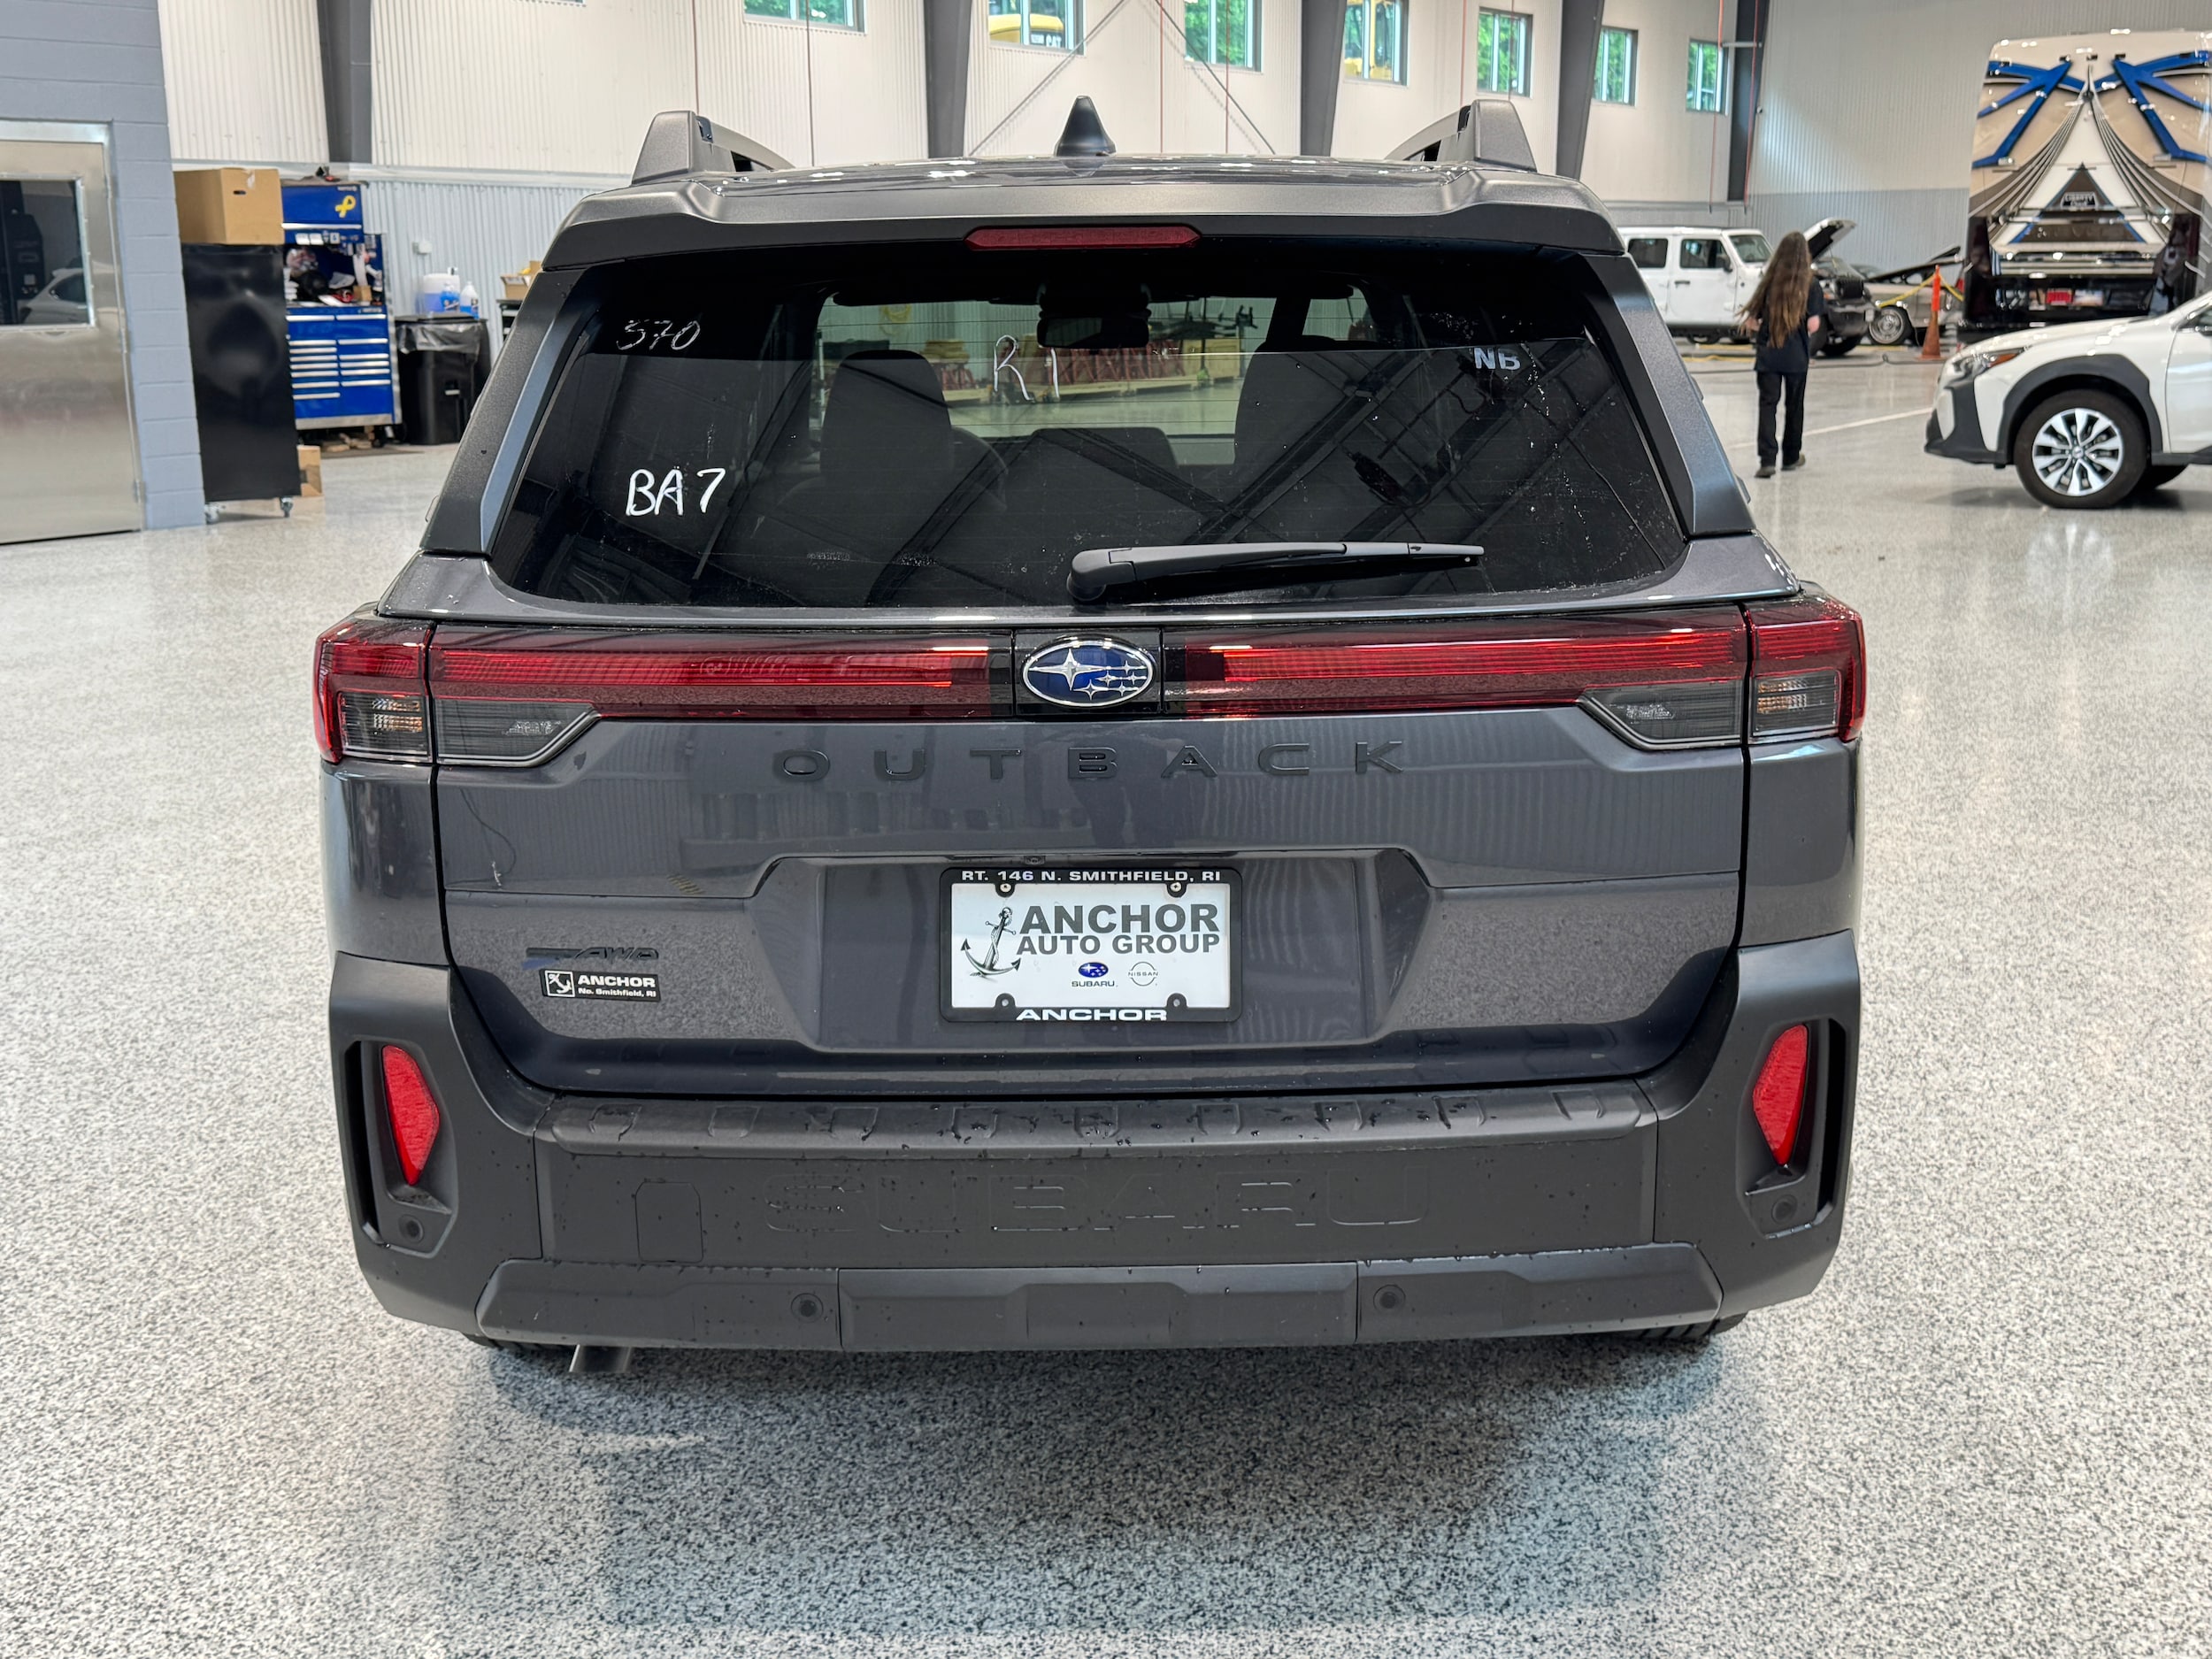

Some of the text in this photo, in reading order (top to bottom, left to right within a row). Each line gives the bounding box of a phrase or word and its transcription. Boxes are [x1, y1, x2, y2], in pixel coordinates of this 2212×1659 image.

[617, 319, 702, 350] 570
[780, 740, 1404, 781] OUTBACK
[962, 871, 1221, 883] RT. 146 N. SMITHFIELD, RI
[1019, 903, 1220, 934] ANCHOR
[1017, 933, 1220, 956] AUTO GROUP
[575, 947, 659, 964] AWD
[578, 974, 657, 988] ANCHOR
[595, 987, 644, 998] Smithfield,
[1016, 1009, 1167, 1022] ANCHOR
[764, 1165, 1430, 1233] SUBARU
